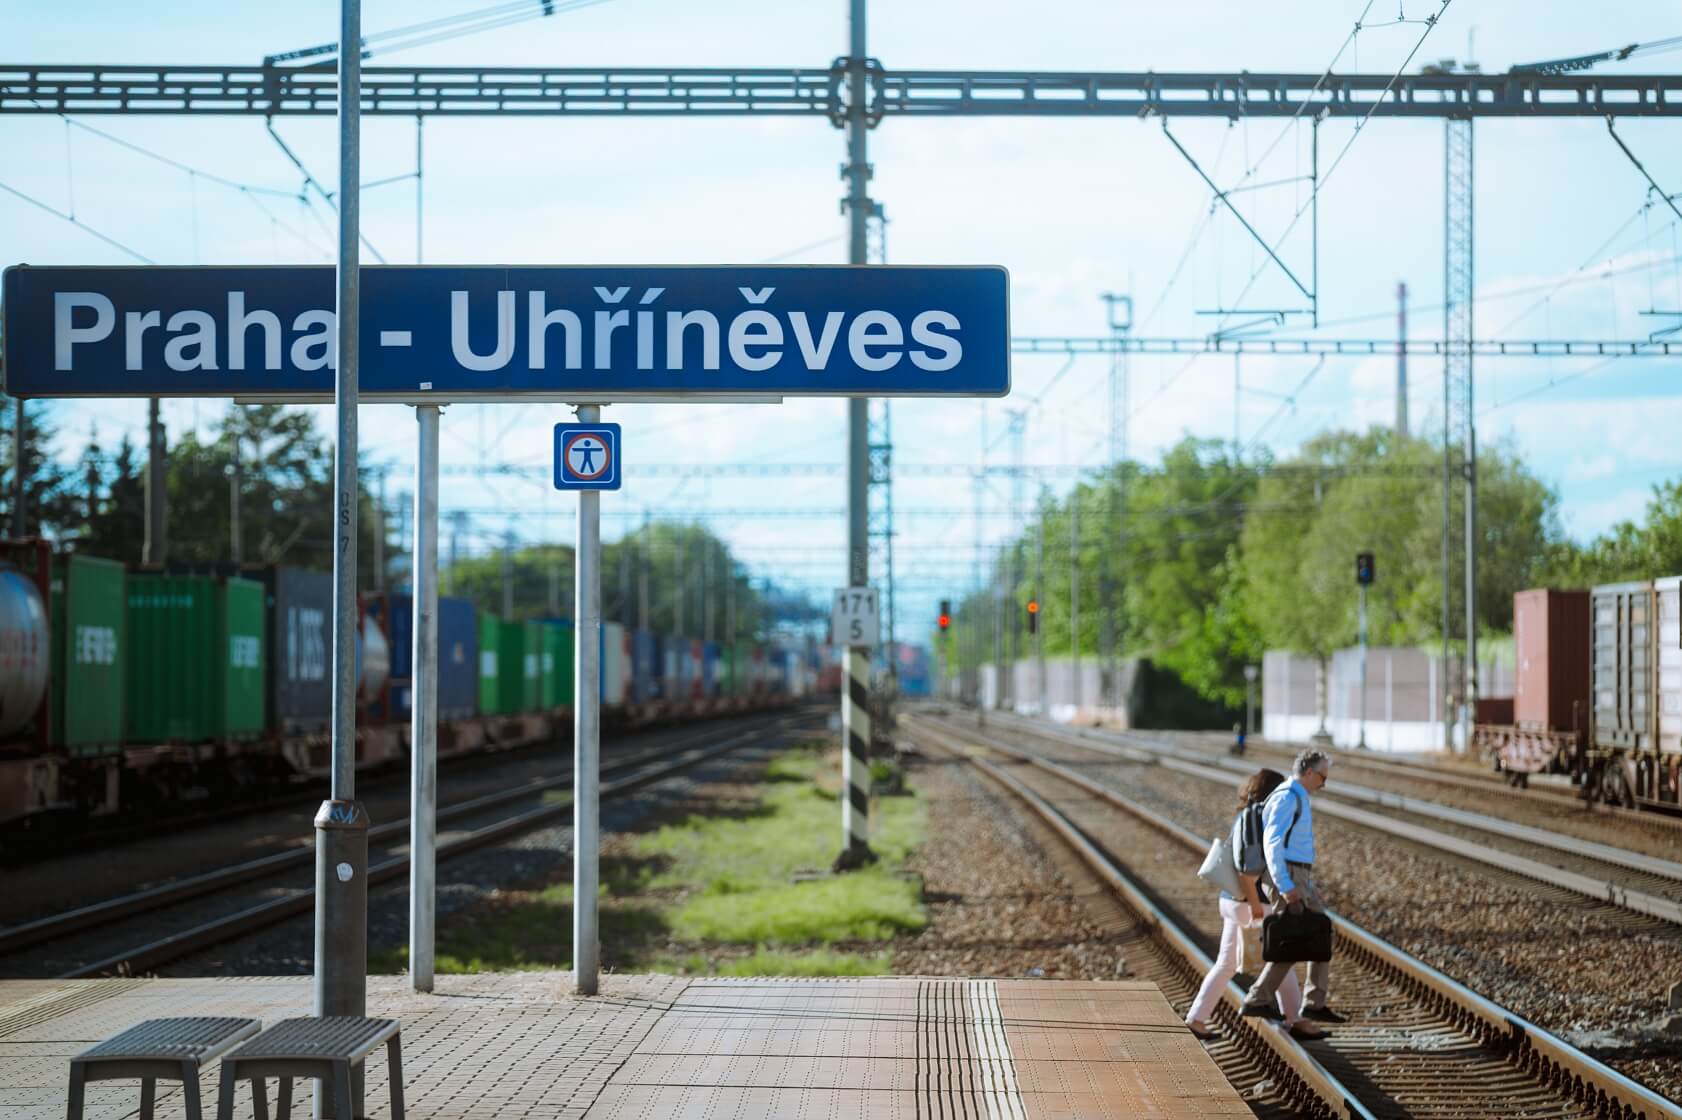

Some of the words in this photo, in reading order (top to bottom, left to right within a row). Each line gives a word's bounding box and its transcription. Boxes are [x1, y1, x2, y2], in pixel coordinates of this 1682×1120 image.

[54, 290, 336, 371] Praha
[450, 287, 963, 372] Uhříněves
[839, 593, 874, 616] 171
[850, 618, 863, 640] 5
